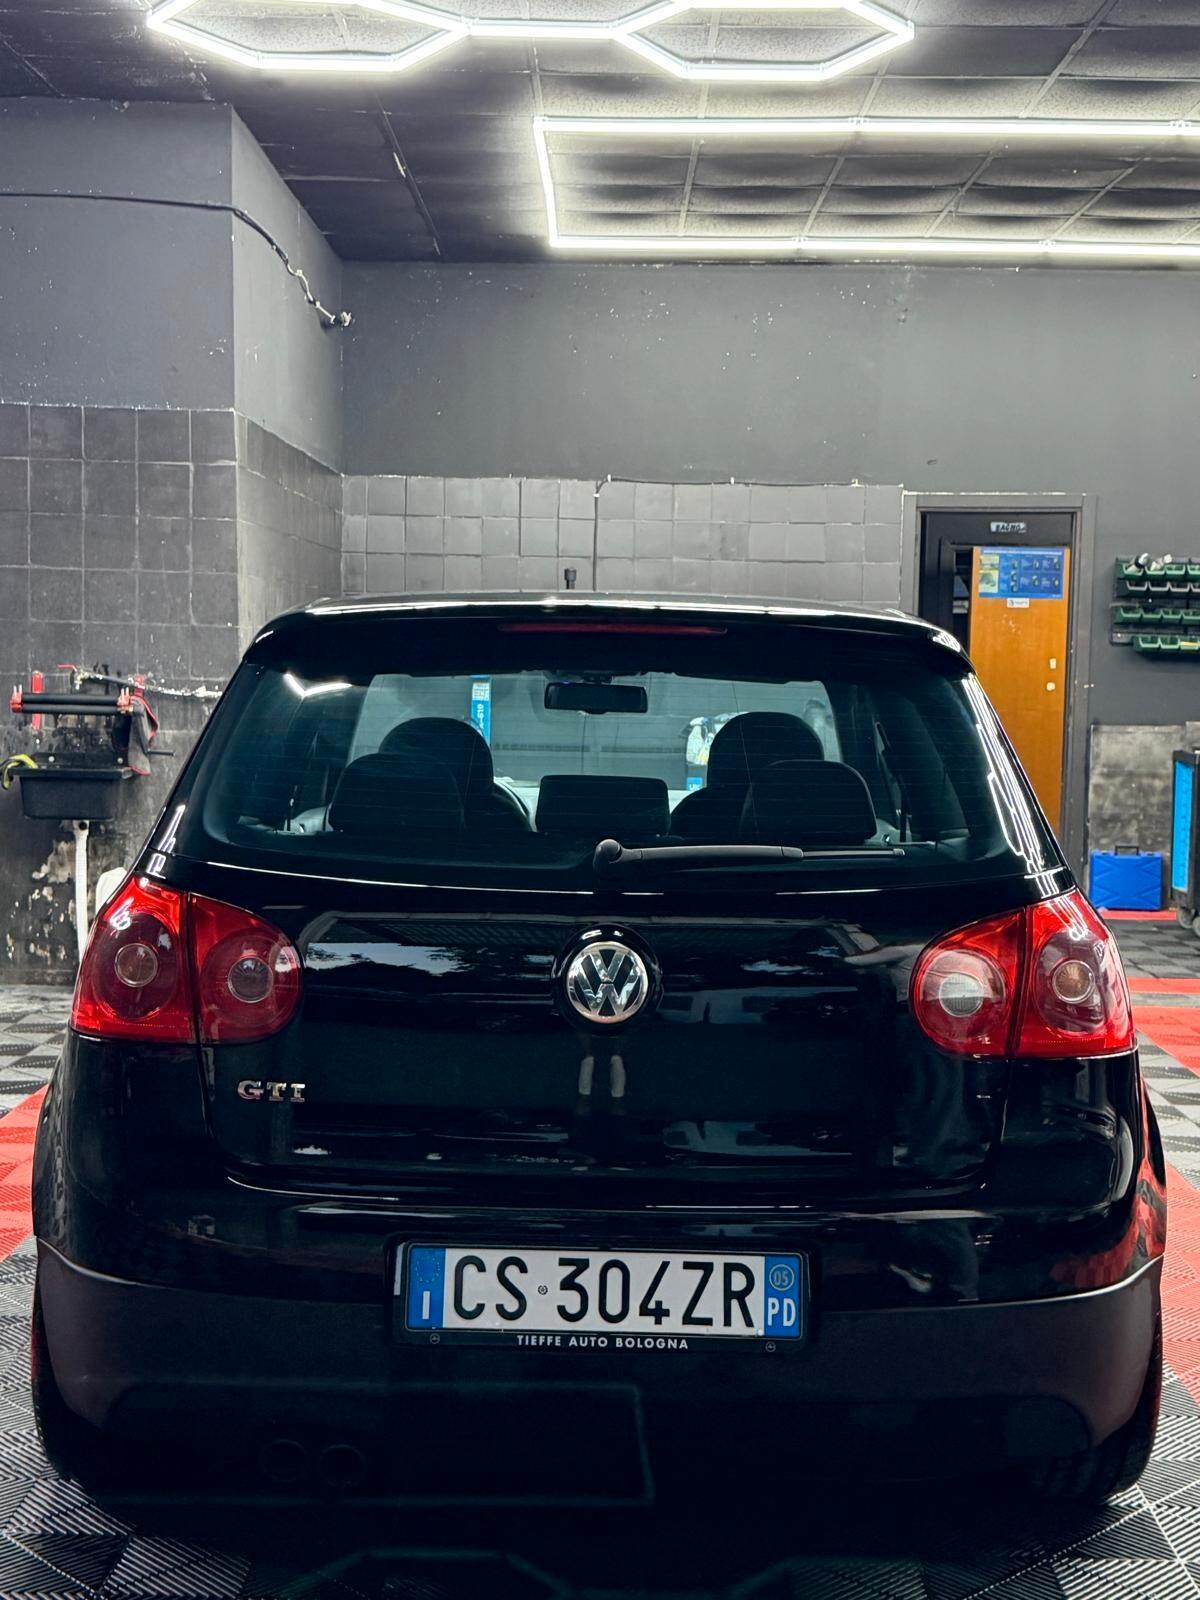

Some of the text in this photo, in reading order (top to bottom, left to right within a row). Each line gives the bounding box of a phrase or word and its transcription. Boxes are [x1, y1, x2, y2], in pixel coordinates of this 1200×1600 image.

[237, 1079, 306, 1103] GTI
[773, 1270, 789, 1286] 05
[453, 1254, 756, 1329] CS 304ZR
[767, 1297, 796, 1327] PD
[516, 1335, 689, 1350] TIEFFE AUTO BOLOGNA
